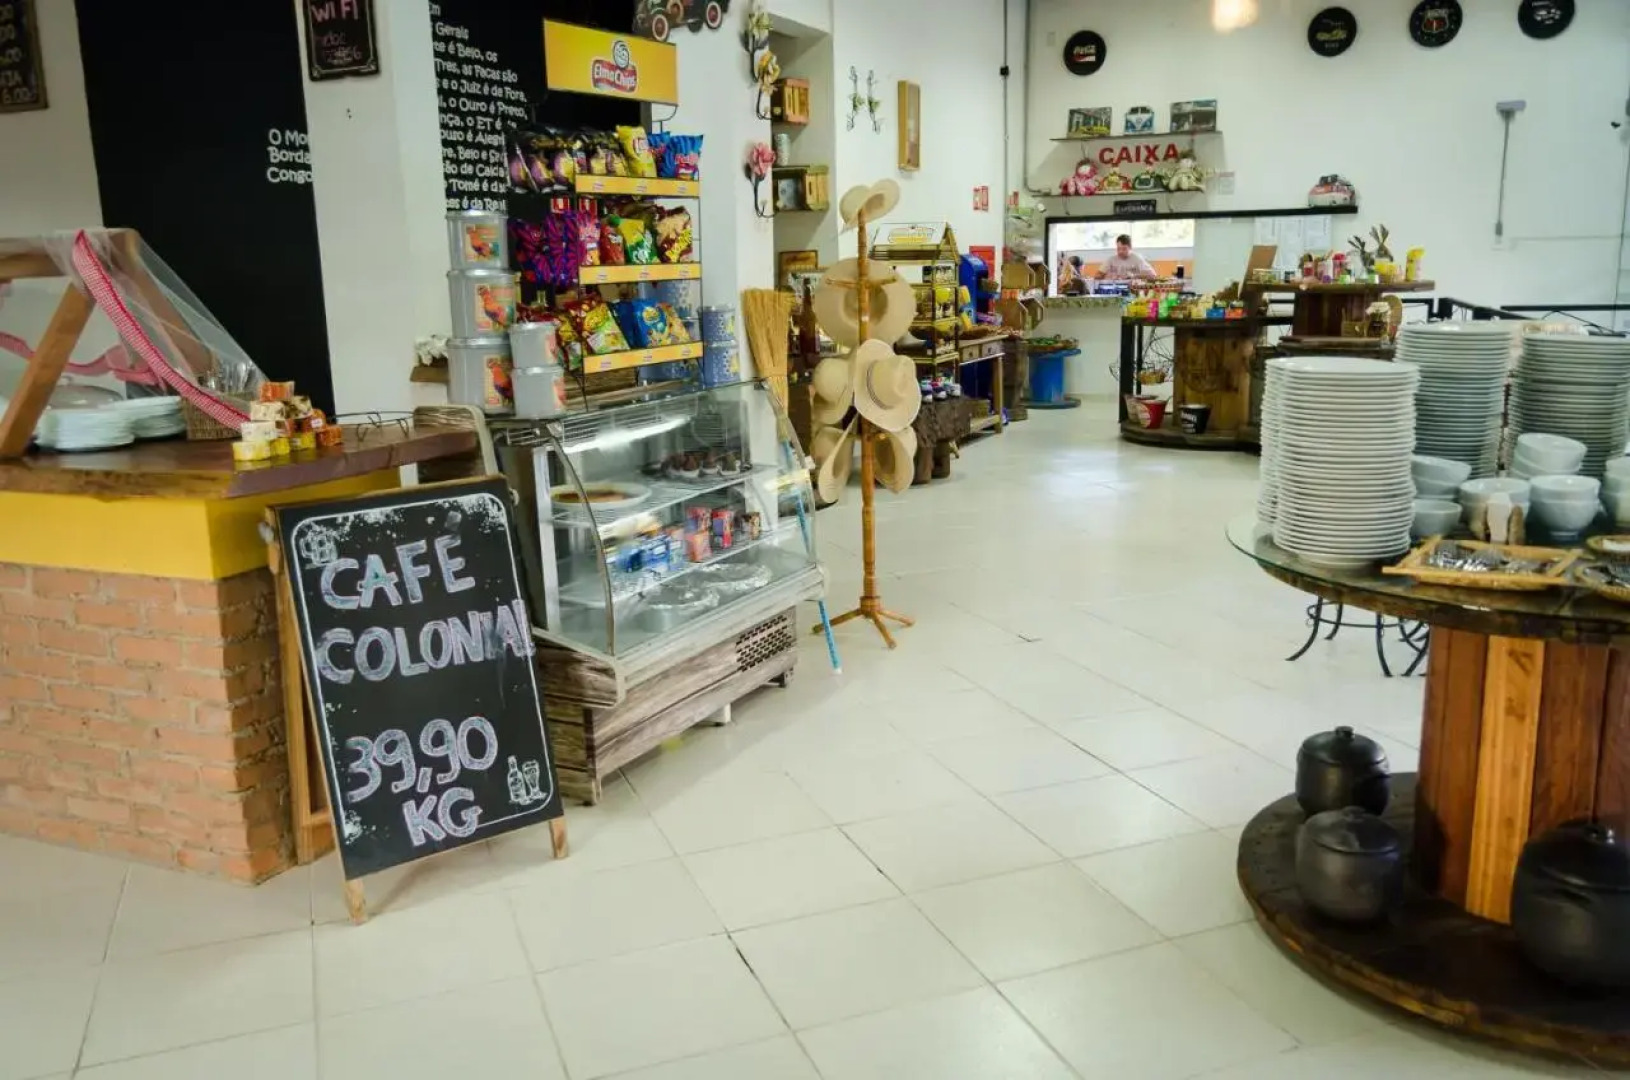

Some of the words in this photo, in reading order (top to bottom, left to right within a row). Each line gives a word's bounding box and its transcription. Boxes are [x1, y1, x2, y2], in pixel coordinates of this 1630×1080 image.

[486, 51, 498, 63] os
[451, 79, 458, 90] o
[491, 85, 503, 97] de
[449, 97, 457, 108] o
[459, 98, 487, 112] Ouro
[466, 117, 474, 127] o
[476, 116, 493, 131] ET
[268, 128, 282, 145] O
[1098, 143, 1181, 164] CAIXA
[319, 534, 476, 610] CAFE
[345, 716, 499, 803] 39,90
[402, 786, 483, 847] KG
